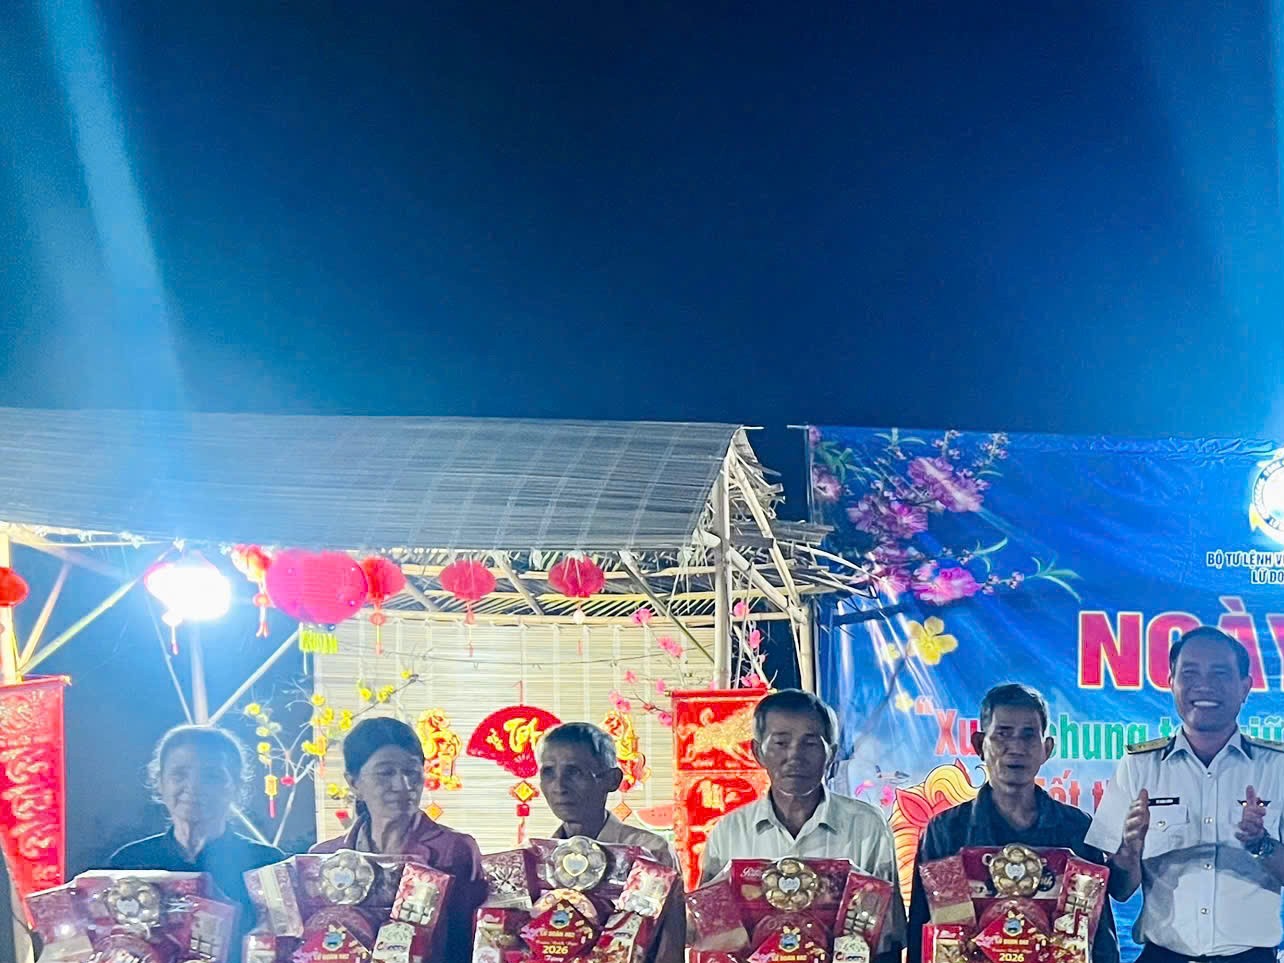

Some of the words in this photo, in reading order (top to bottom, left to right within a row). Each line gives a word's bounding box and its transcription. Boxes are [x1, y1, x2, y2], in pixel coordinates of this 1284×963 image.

[1206, 549, 1223, 569] BỘ
[1226, 551, 1243, 566] TƯ
[1243, 549, 1272, 569] LỆNH
[542, 945, 569, 955] 2026
[999, 953, 1025, 962] 2026
